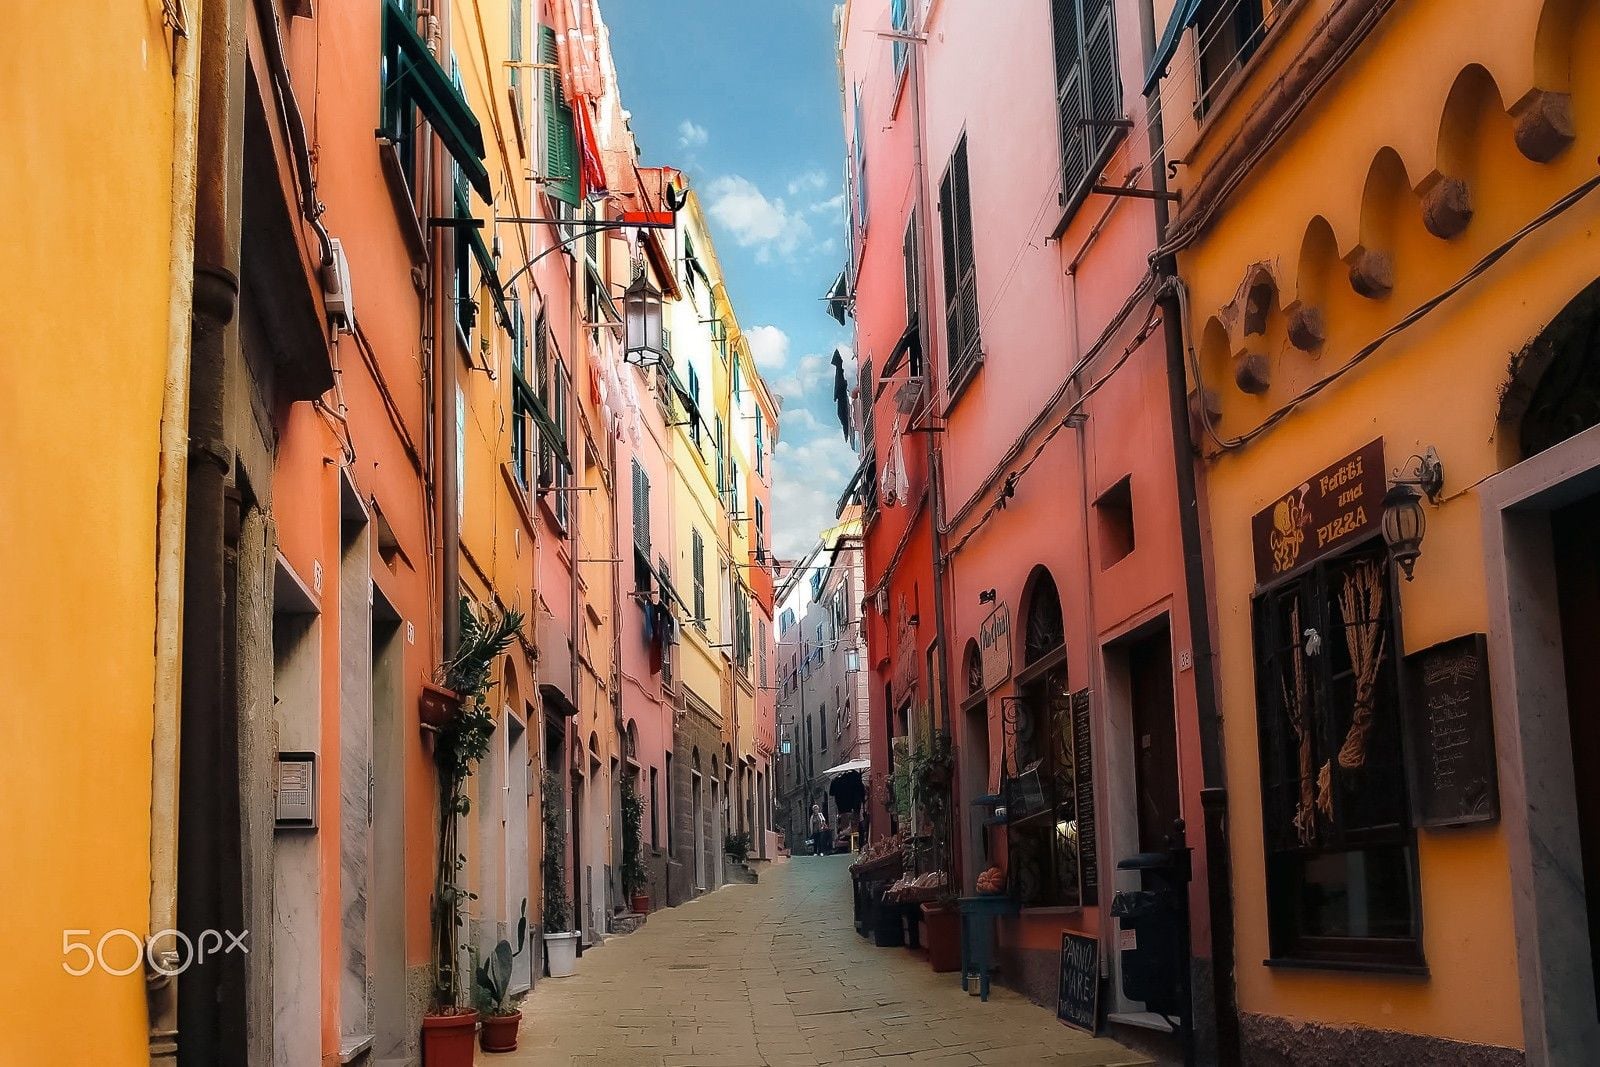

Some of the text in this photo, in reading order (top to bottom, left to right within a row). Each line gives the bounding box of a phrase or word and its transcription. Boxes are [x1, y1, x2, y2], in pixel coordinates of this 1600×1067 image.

[1319, 455, 1364, 498] Fatti
[1337, 482, 1364, 509] una
[1316, 505, 1368, 548] PIZZA
